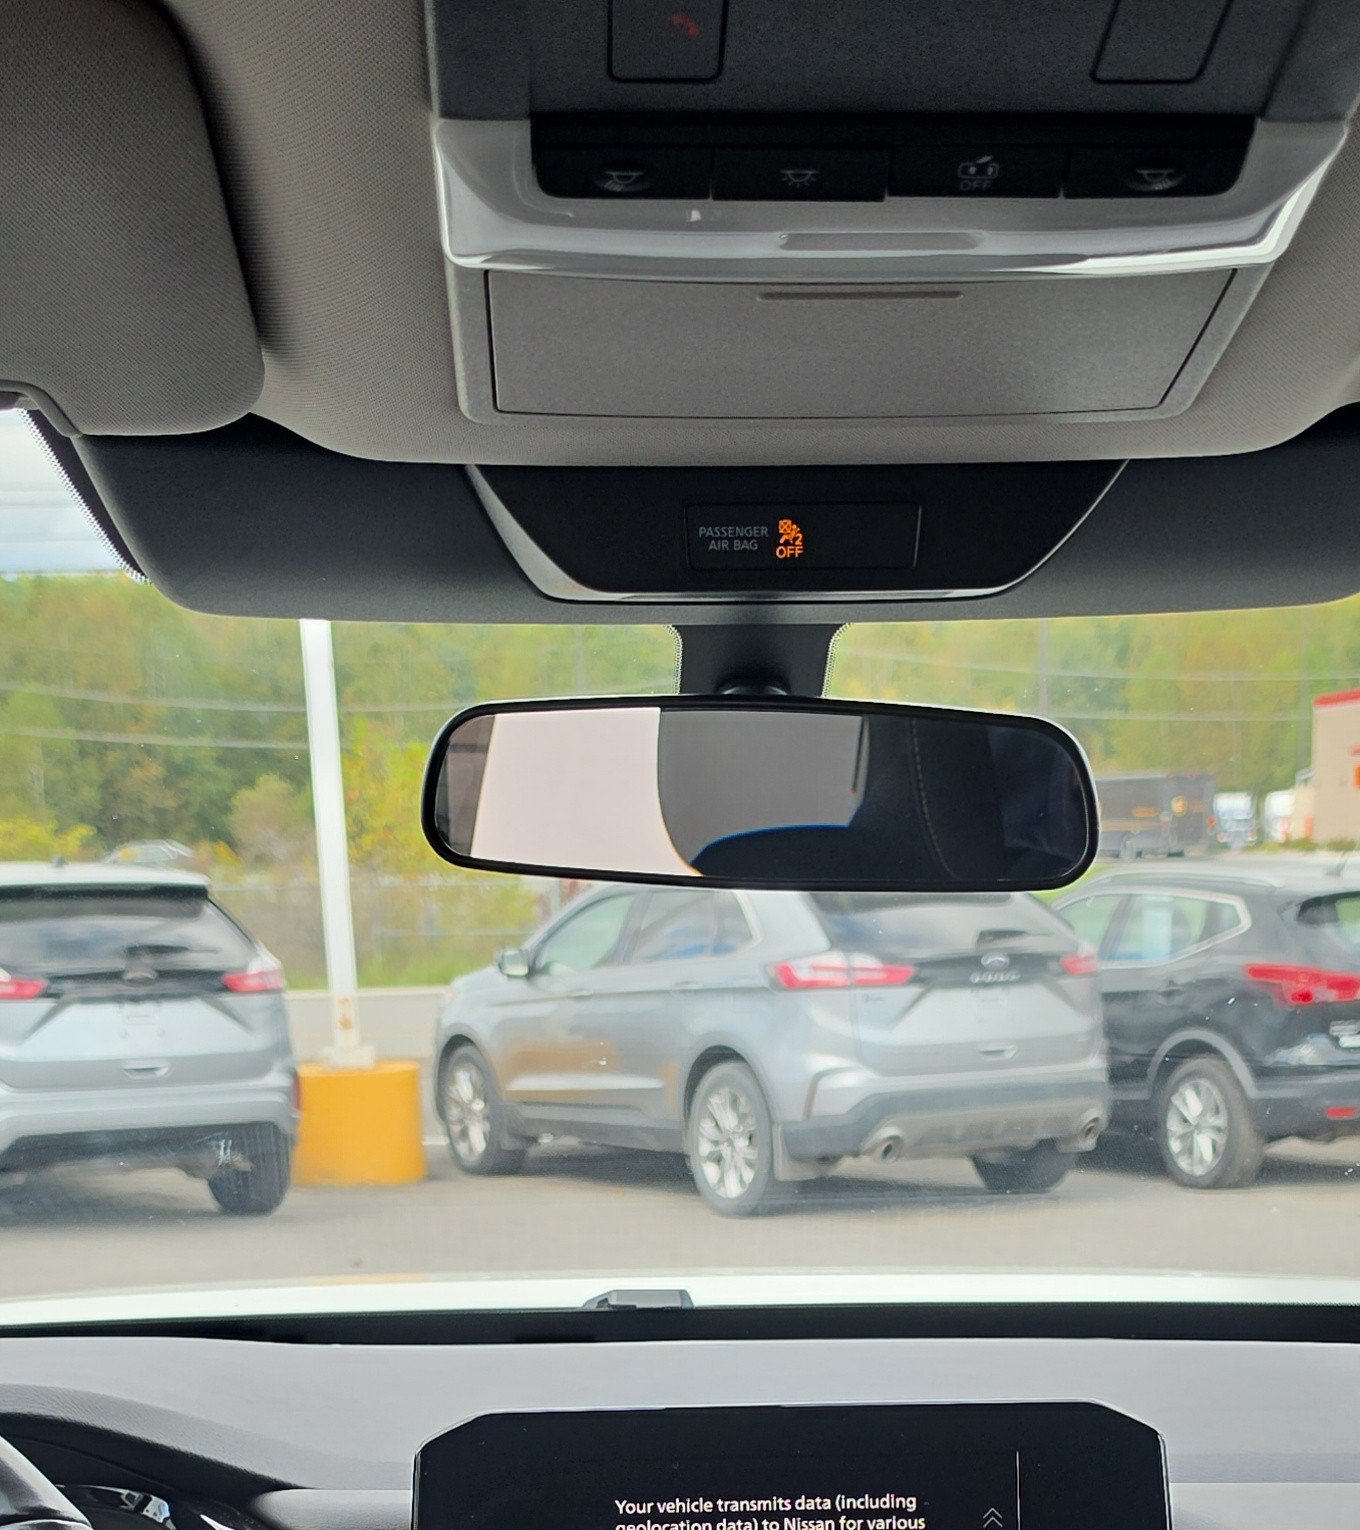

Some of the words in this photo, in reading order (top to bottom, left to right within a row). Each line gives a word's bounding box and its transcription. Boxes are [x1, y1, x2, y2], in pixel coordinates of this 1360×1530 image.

[960, 181, 990, 190] OFF
[699, 527, 768, 537] PASSENGER
[709, 540, 728, 550] AIR
[734, 540, 758, 550] BAG
[776, 546, 803, 558] OFF
[615, 1500, 653, 1514] Your
[657, 1499, 712, 1513] vehicle
[717, 1498, 791, 1511] transmits
[795, 1496, 831, 1510] data
[835, 1494, 917, 1511] (including
[839, 1517, 863, 1530] for
[867, 1517, 926, 1530] various
